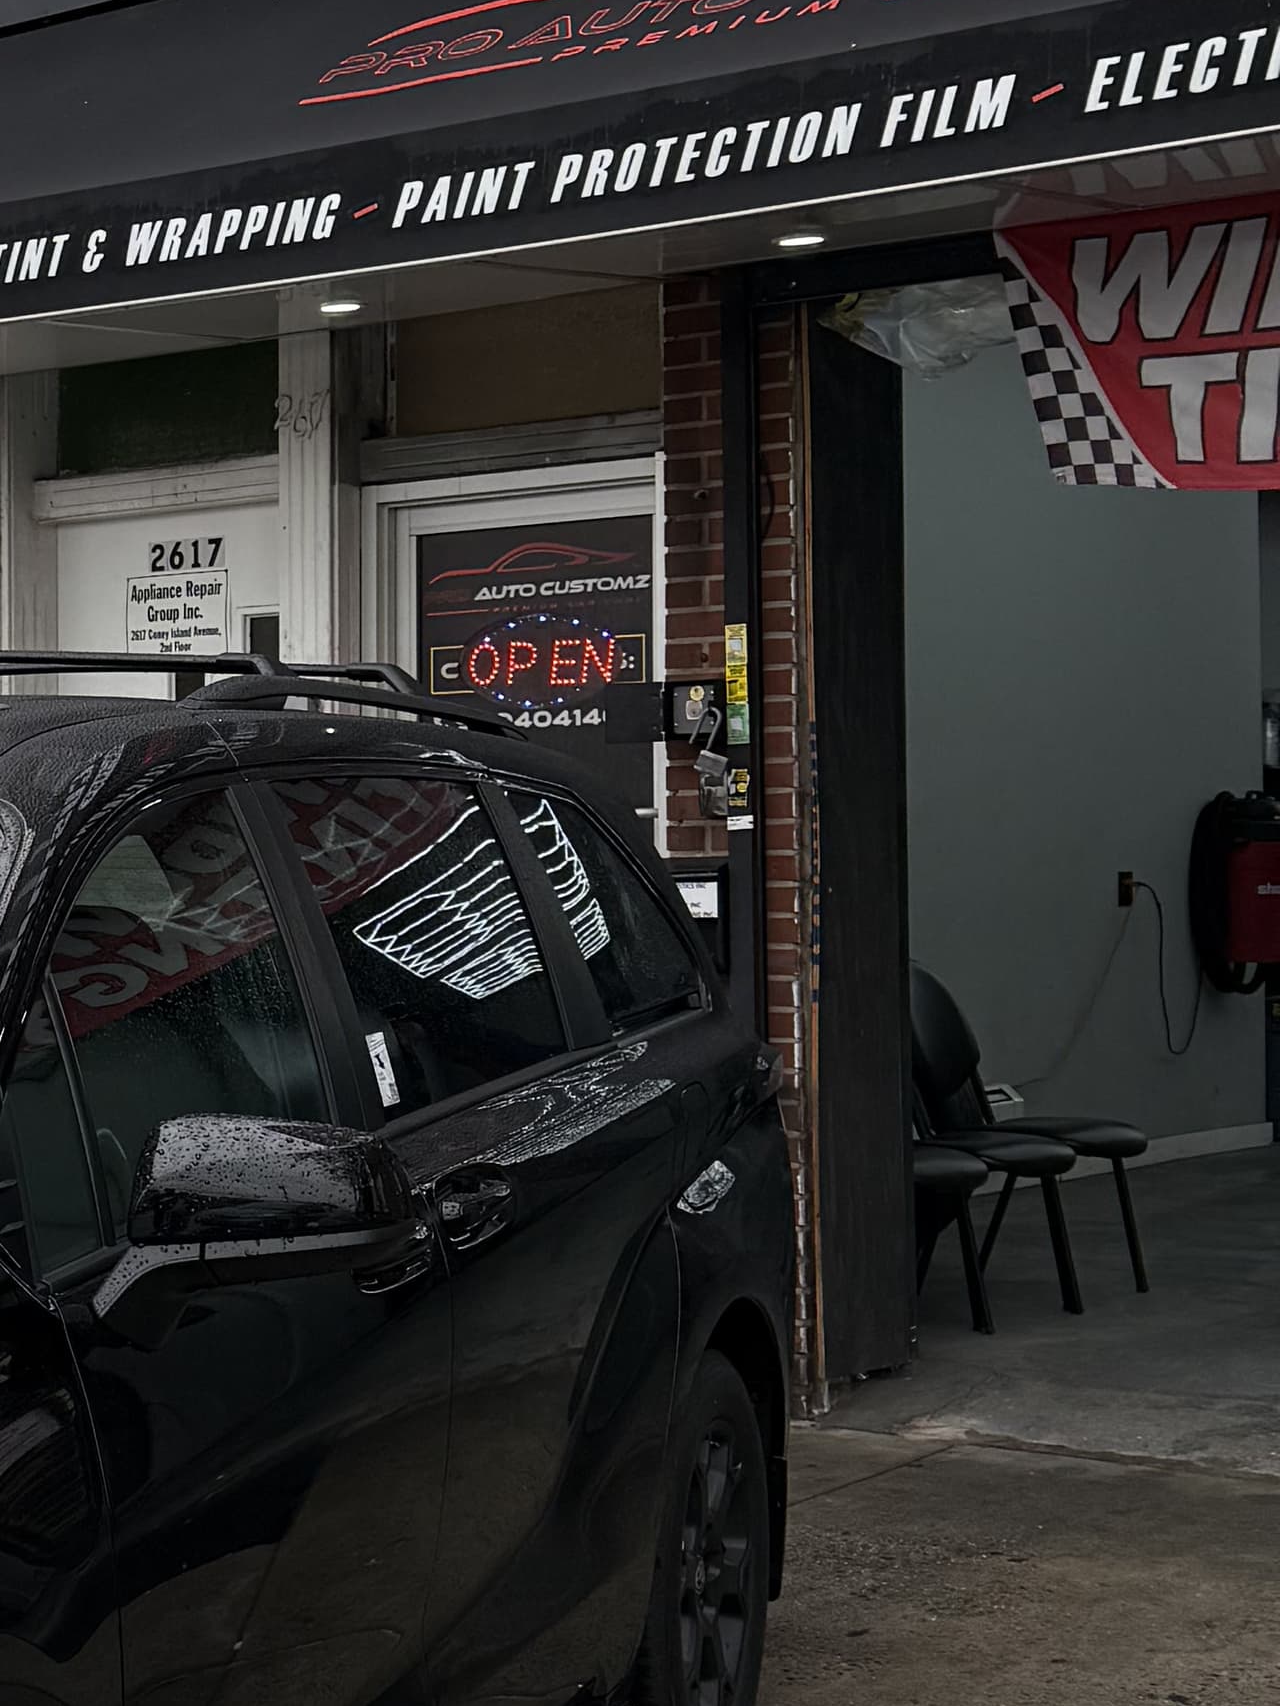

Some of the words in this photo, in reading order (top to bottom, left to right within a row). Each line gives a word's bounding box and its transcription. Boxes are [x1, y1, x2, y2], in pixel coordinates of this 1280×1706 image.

[319, 28, 503, 83] PRO
[82, 228, 106, 273] &
[124, 193, 343, 266] WRAPPING
[392, 162, 535, 228] PAINT
[550, 103, 862, 204] PROTECTION
[880, 74, 1016, 148] FILM
[151, 538, 223, 572] 2617
[131, 584, 182, 604] Appliance
[186, 578, 223, 599] Repair
[474, 583, 536, 601] AUTO
[540, 574, 651, 596] CUSTOMZ
[147, 605, 179, 623] Group
[183, 603, 203, 619] Inc.
[171, 627, 191, 638] Island
[160, 642, 172, 652] 2nd
[174, 641, 192, 652] Floor
[468, 637, 616, 687] OPEN
